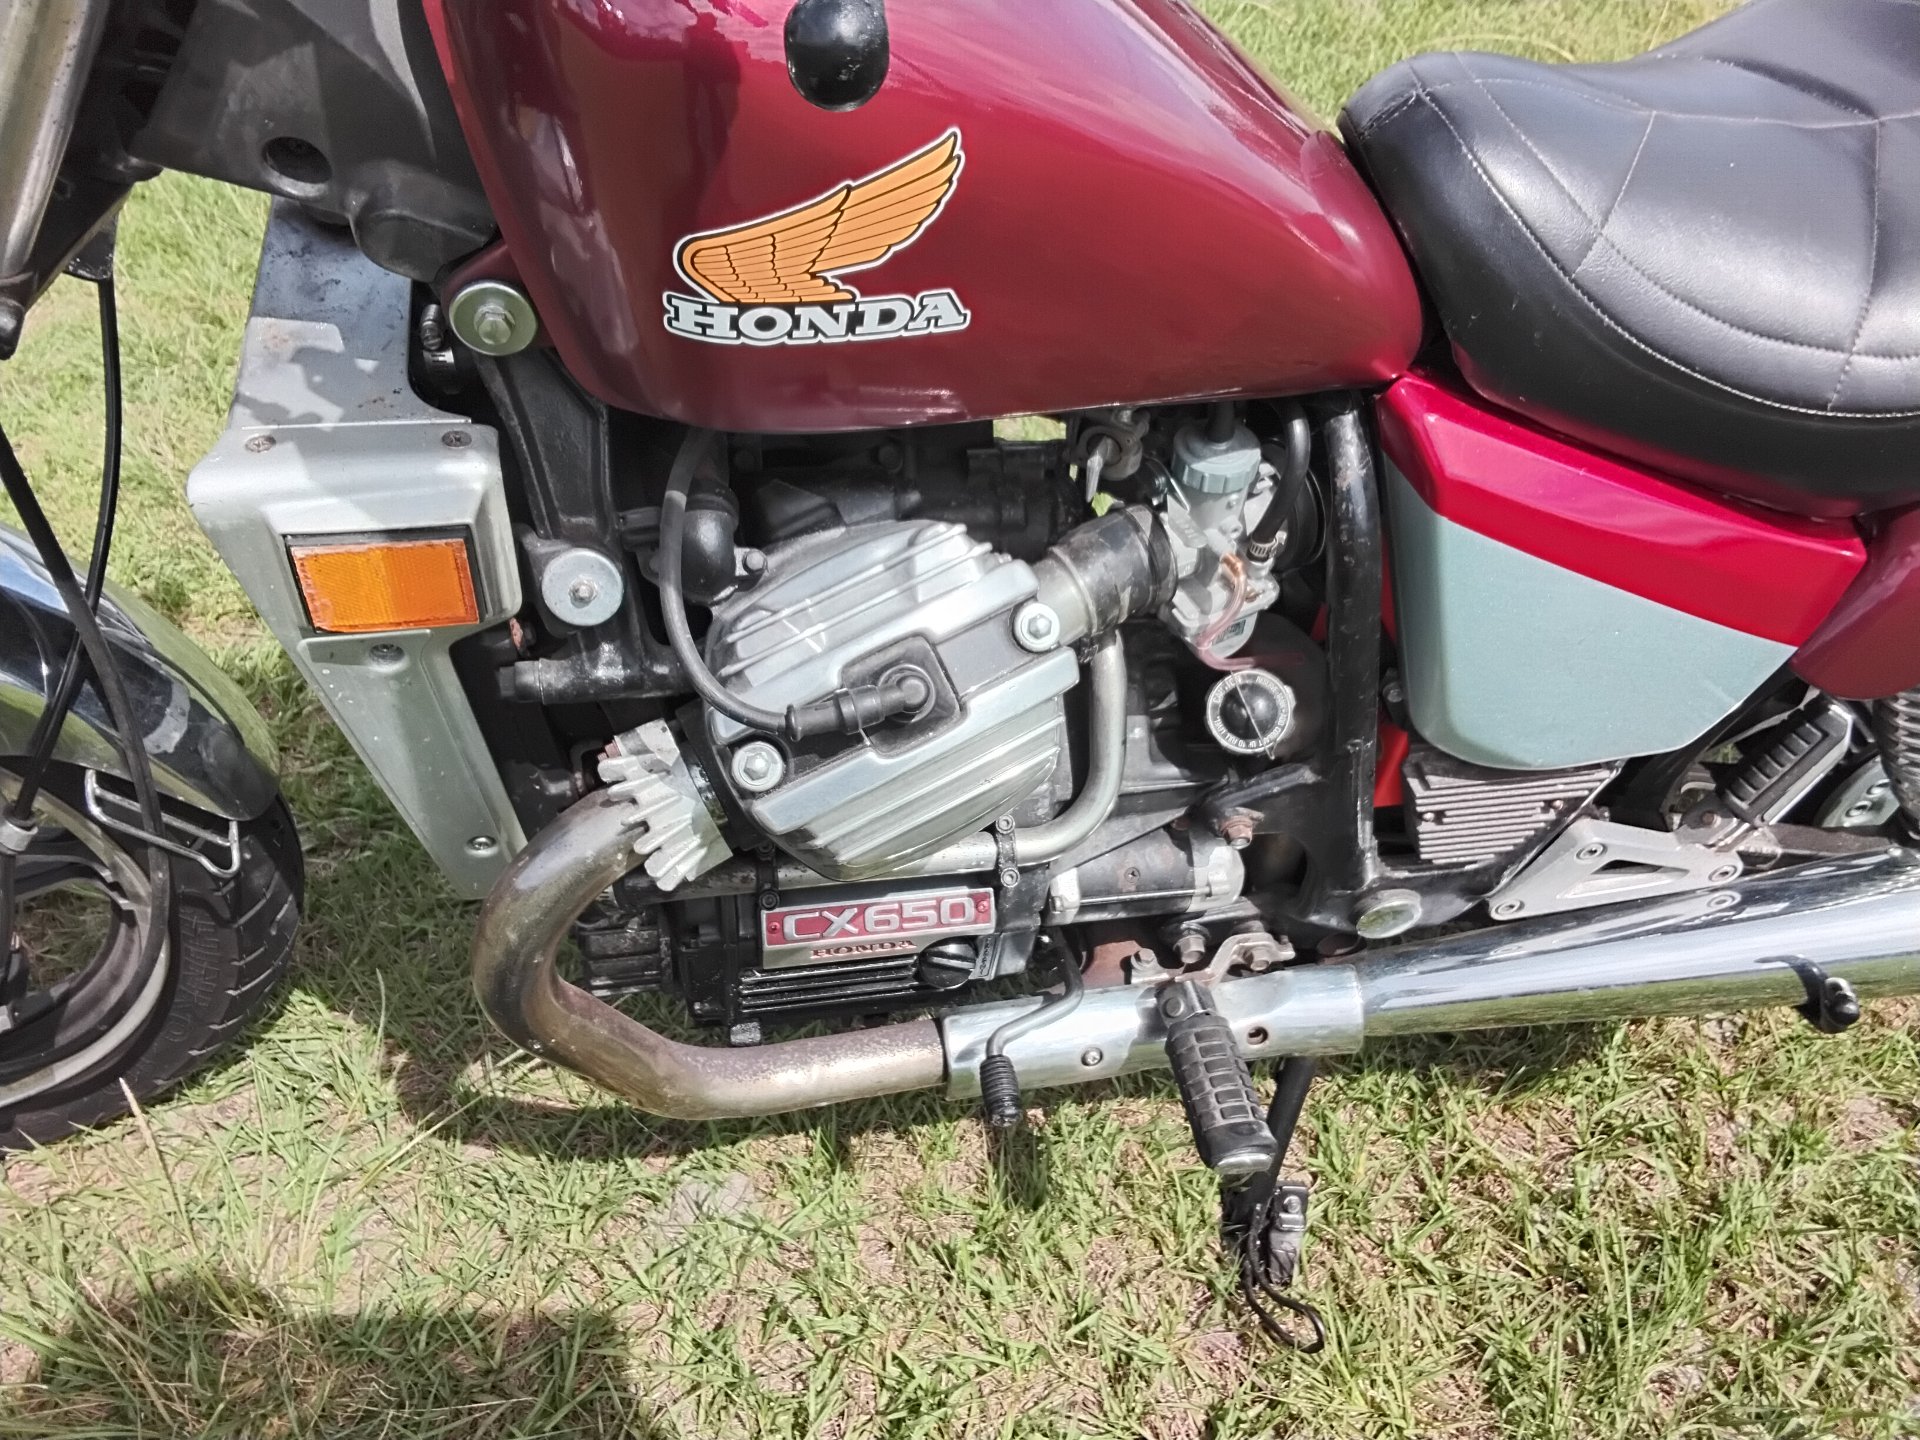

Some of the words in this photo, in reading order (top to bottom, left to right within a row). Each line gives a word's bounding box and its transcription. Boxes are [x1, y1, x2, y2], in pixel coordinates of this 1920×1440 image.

[668, 293, 967, 341] HONDA
[782, 896, 975, 941] CX650
[809, 939, 918, 959] HONDA
